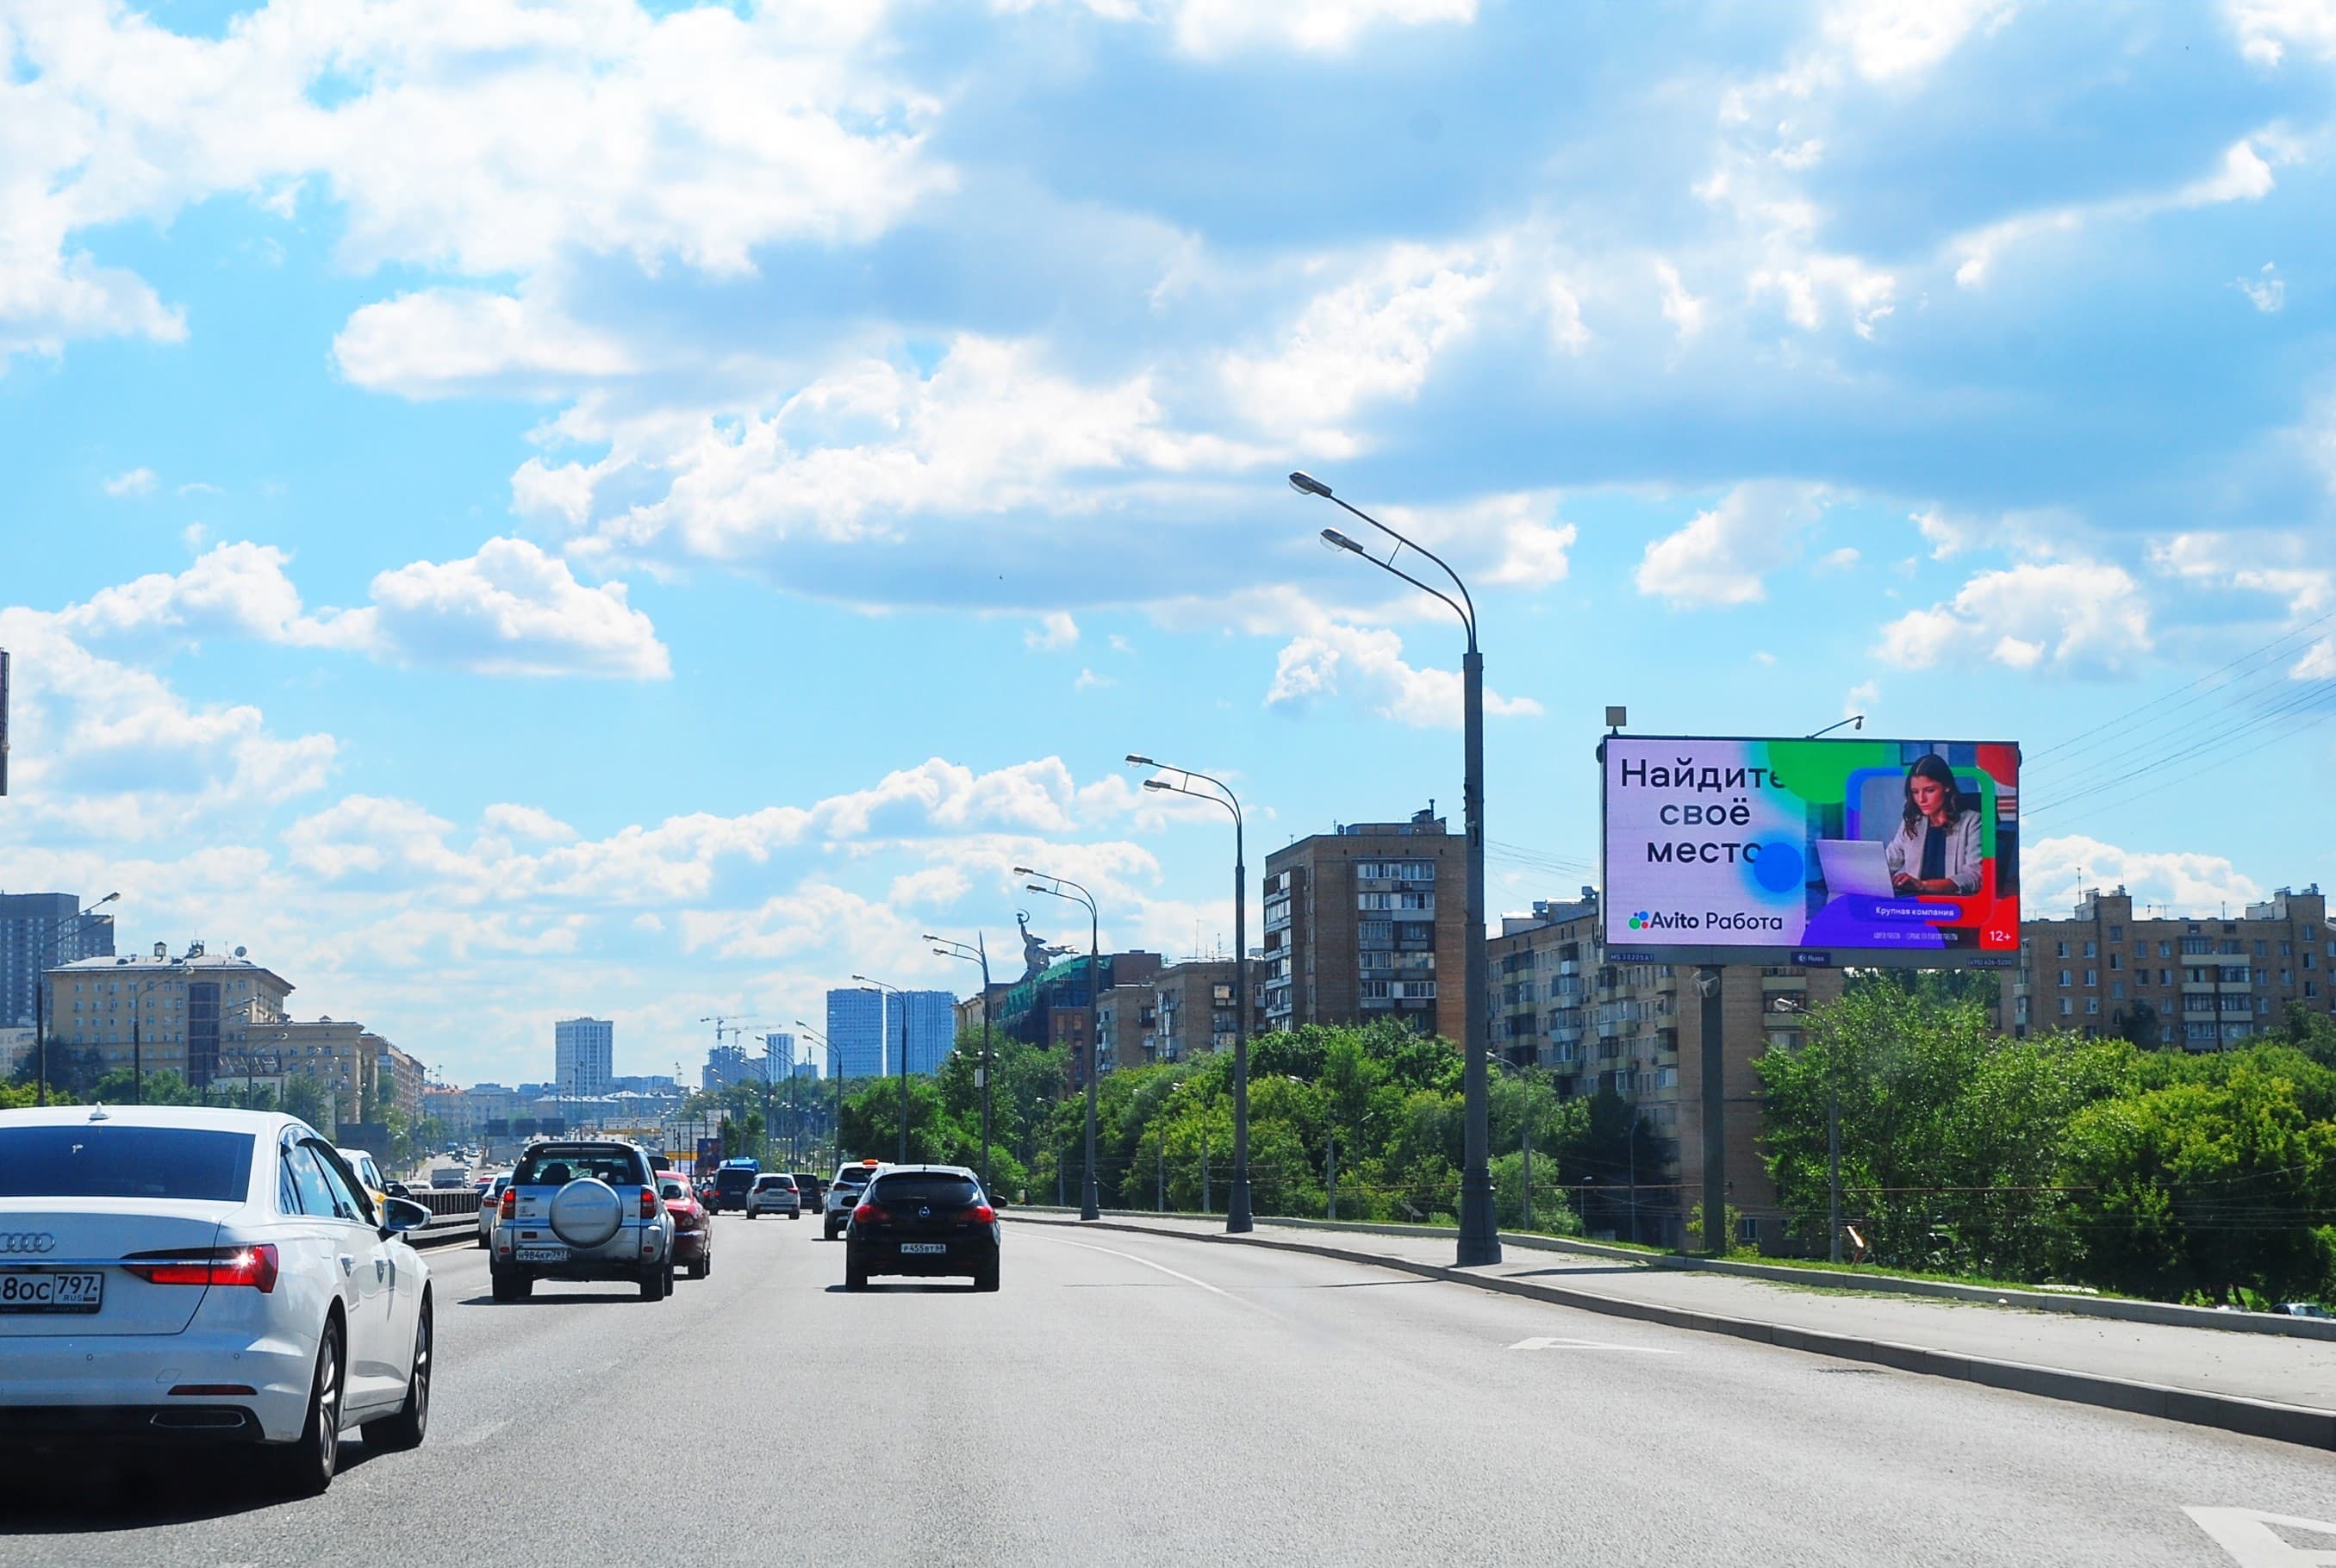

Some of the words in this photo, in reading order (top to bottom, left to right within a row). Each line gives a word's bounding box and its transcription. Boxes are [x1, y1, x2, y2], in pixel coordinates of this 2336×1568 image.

[1621, 757, 1786, 793] Найдите
[1660, 797, 1751, 826] своё
[1647, 842, 1764, 864] место
[1650, 912, 1699, 930] Avito
[1706, 912, 1784, 930] Работа
[1876, 906, 1910, 917] Крупная
[1990, 930, 2011, 942] 12+
[0, 1277, 51, 1301] 8ОС
[57, 1275, 95, 1294] 797
